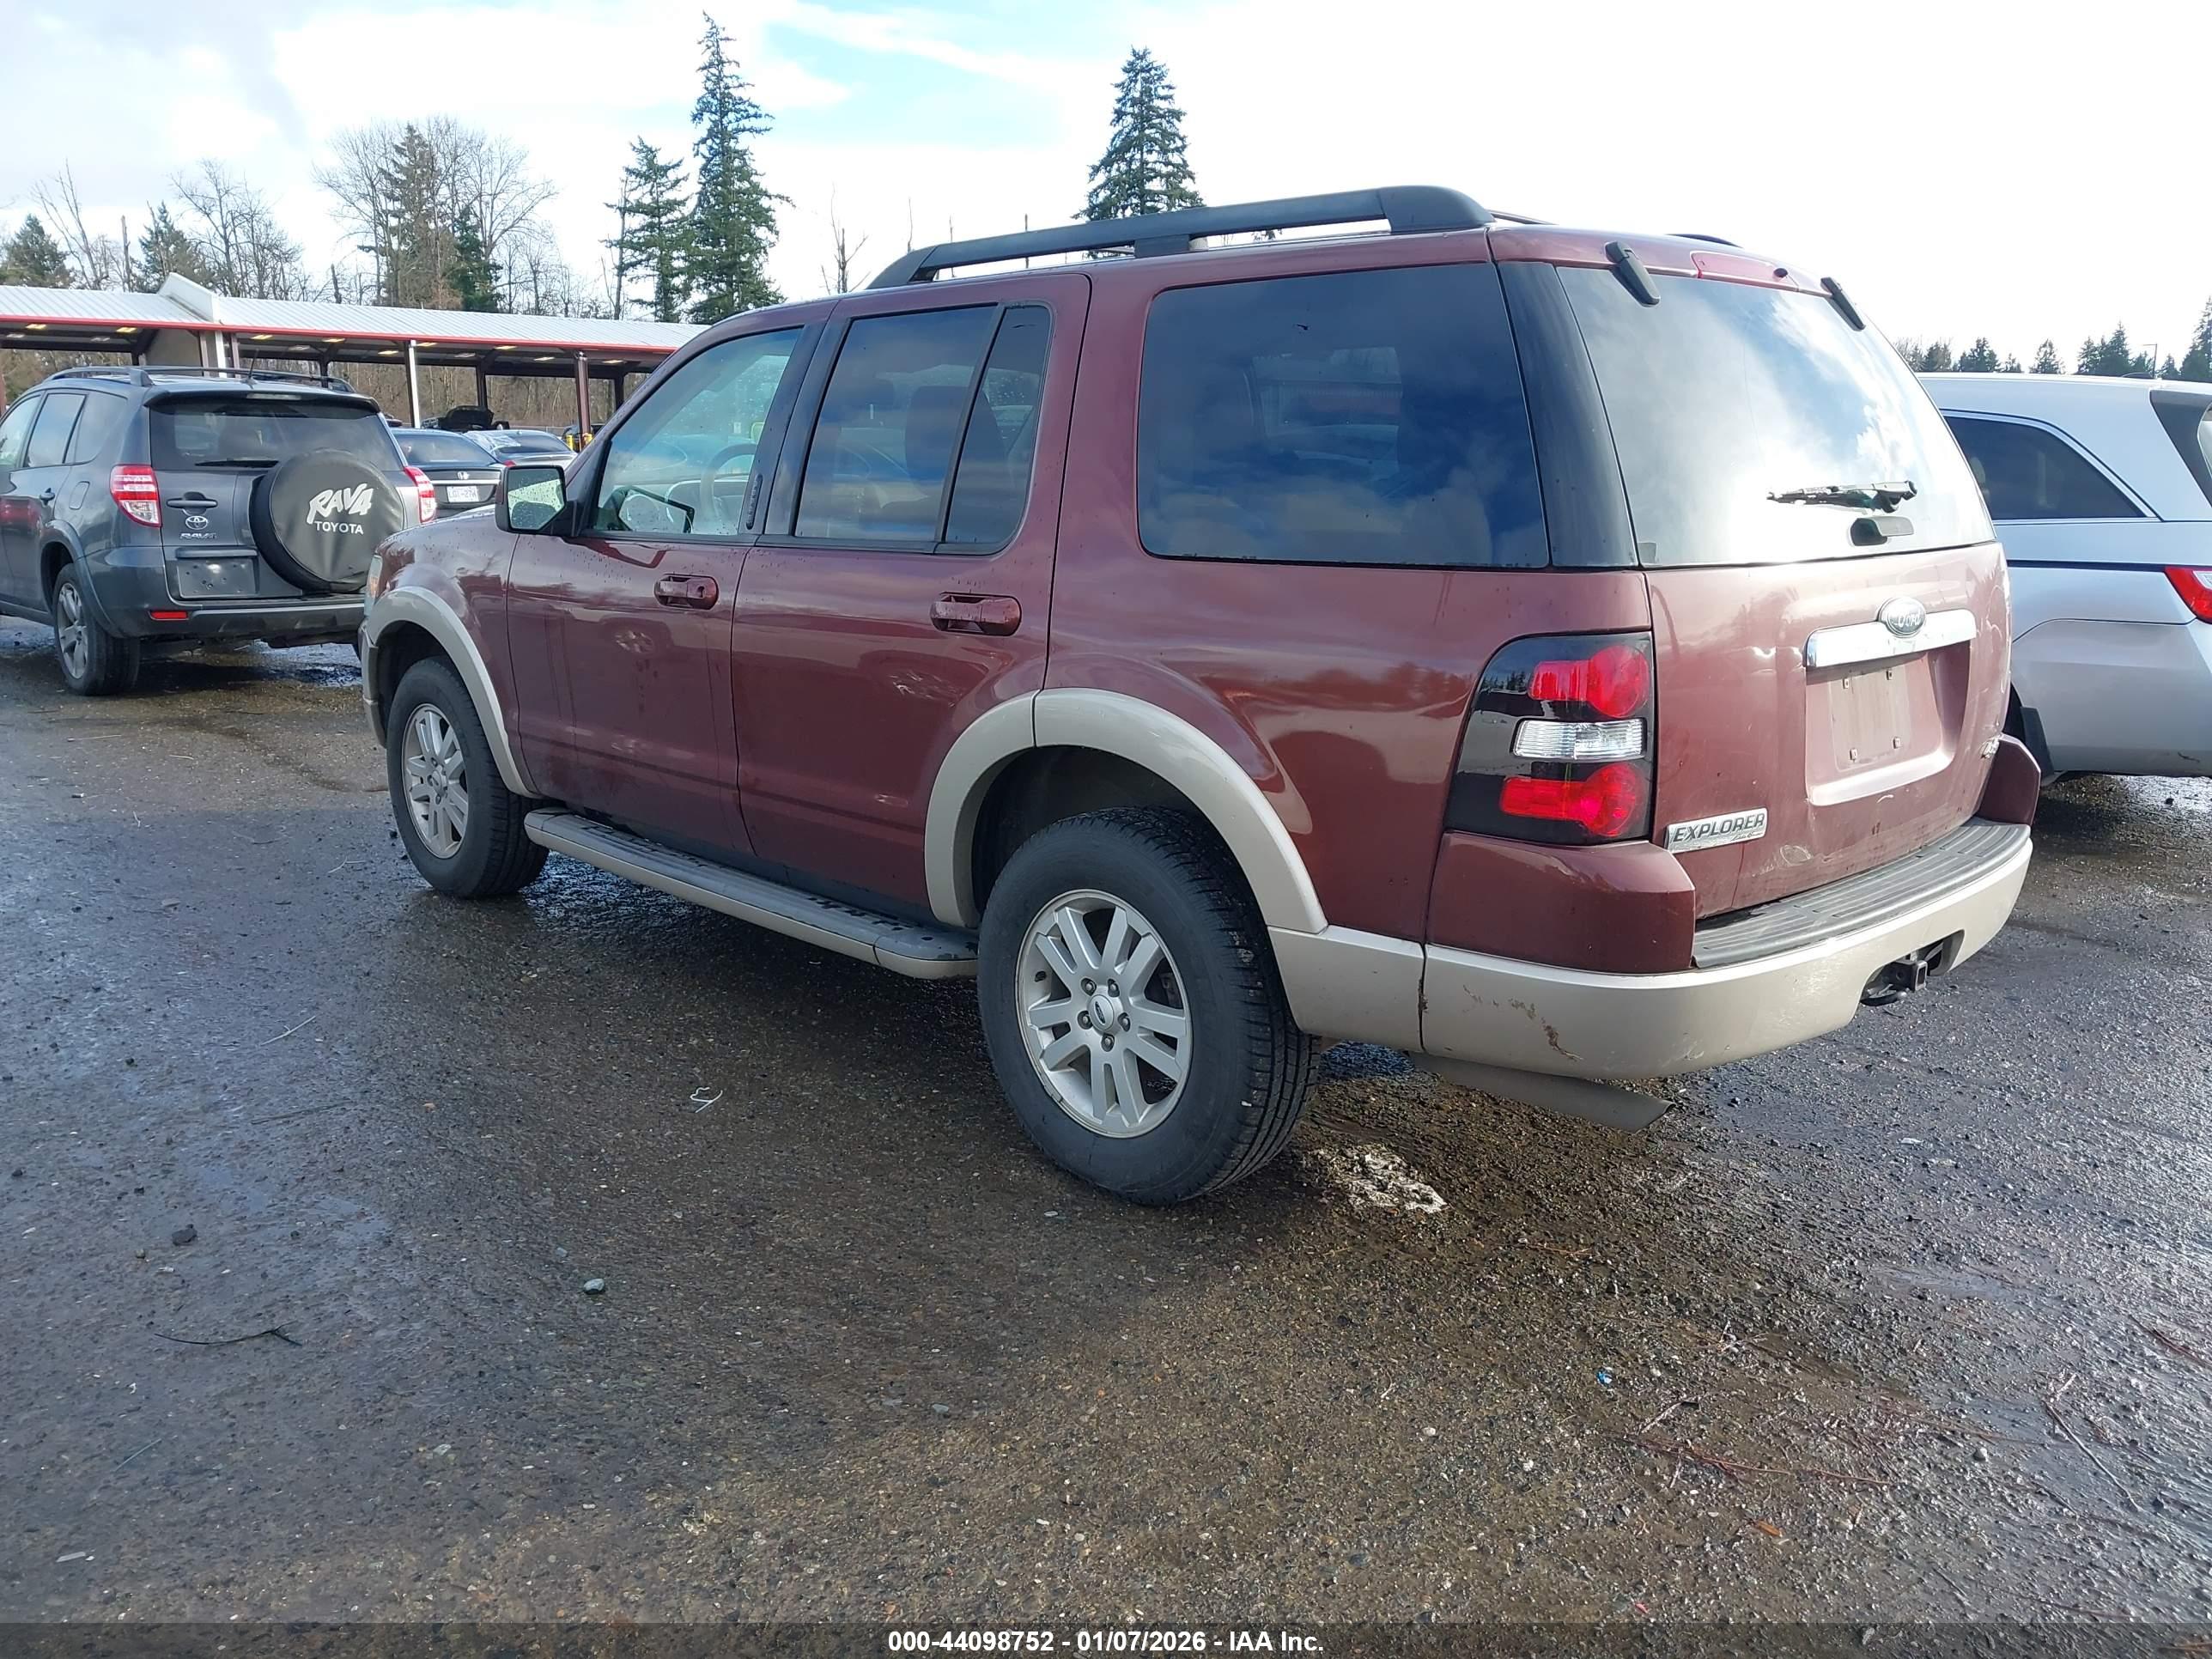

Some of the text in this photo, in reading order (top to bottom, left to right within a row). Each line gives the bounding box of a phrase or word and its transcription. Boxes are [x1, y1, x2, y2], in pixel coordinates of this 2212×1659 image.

[307, 483, 374, 524] RAV4
[314, 520, 364, 534] TOYOTA
[1673, 812, 1765, 842] EXPLORER
